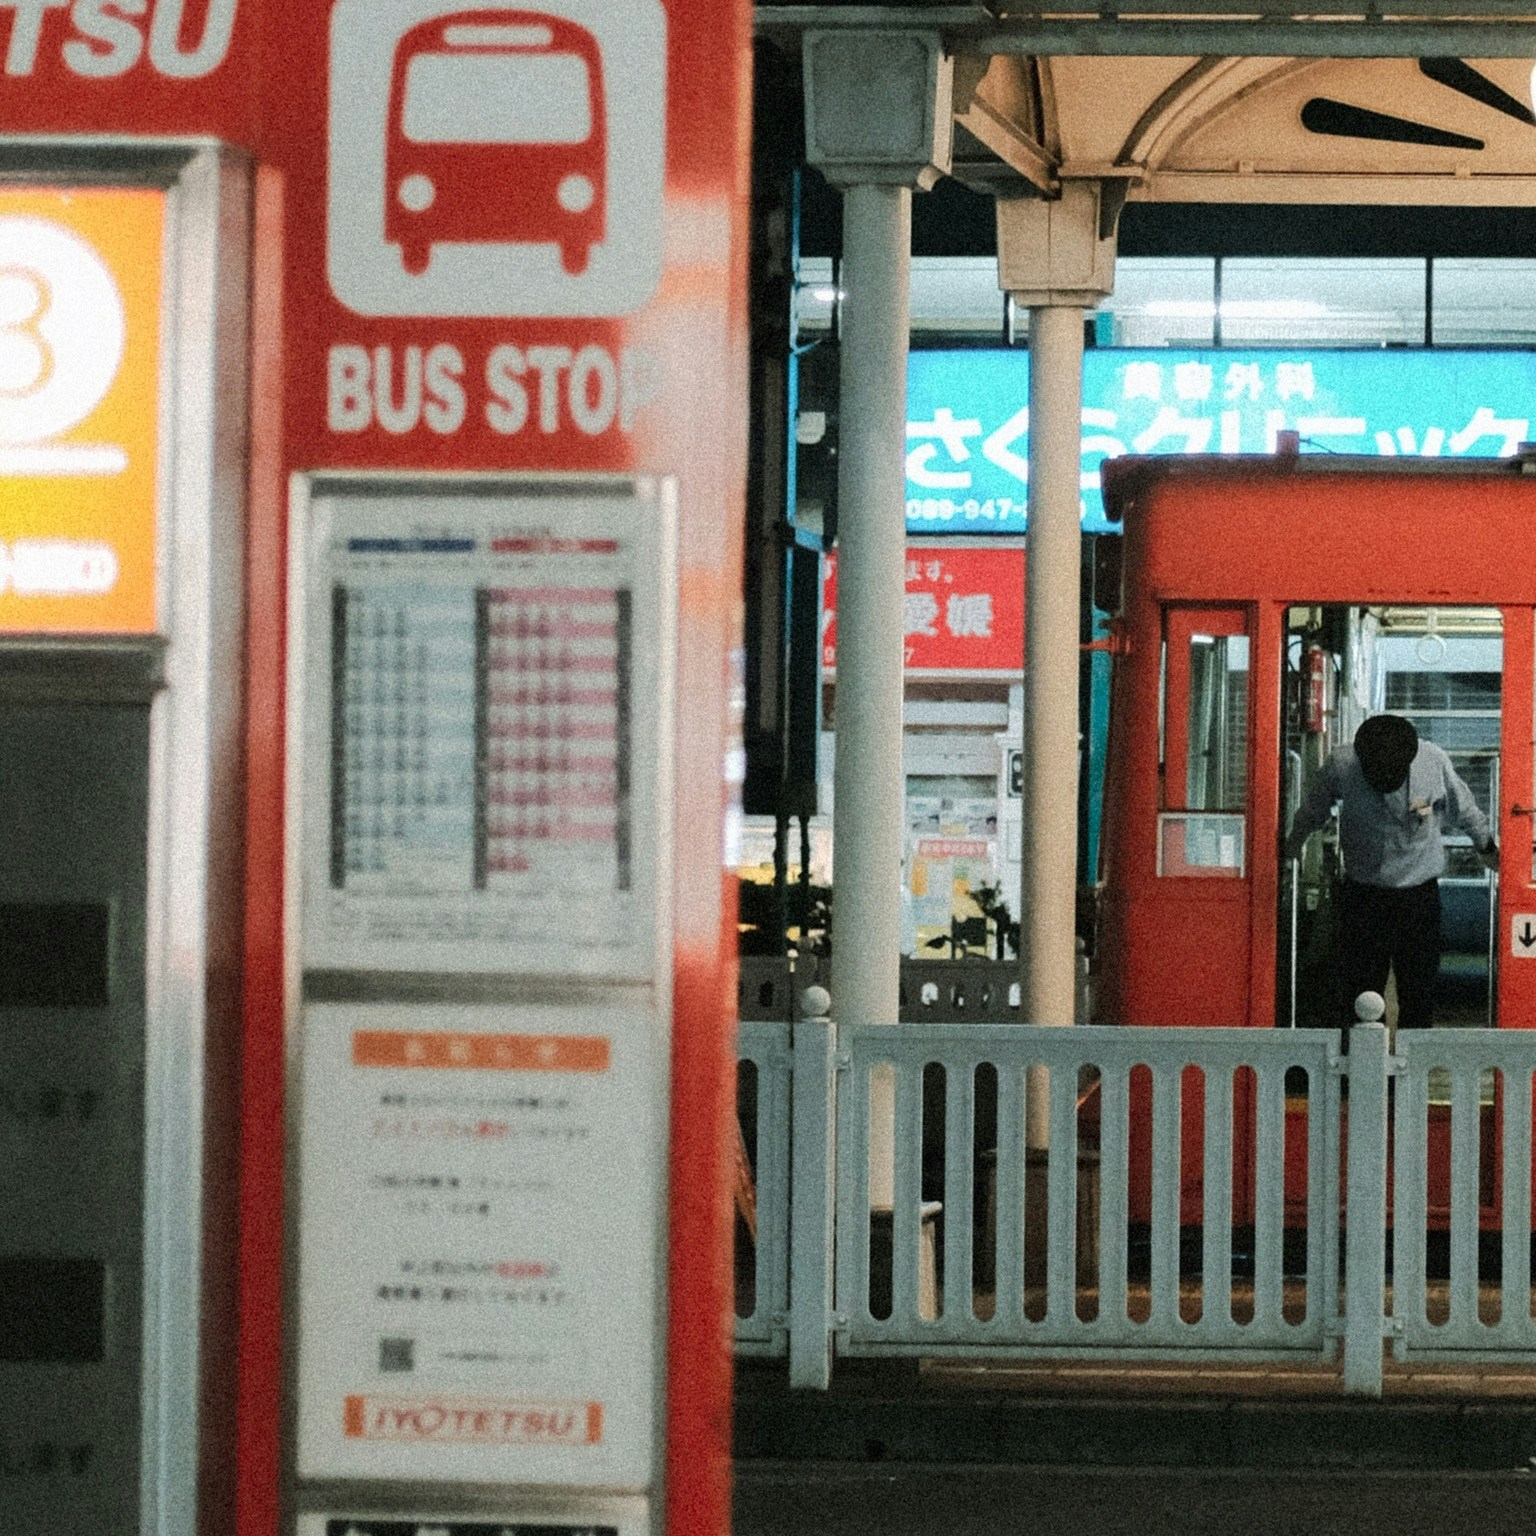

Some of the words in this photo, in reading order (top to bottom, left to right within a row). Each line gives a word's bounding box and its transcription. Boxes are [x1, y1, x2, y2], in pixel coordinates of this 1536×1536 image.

[328, 343, 467, 434] BUS
[486, 343, 664, 435] STOP
[375, 1403, 577, 1435] IYOTETSU
